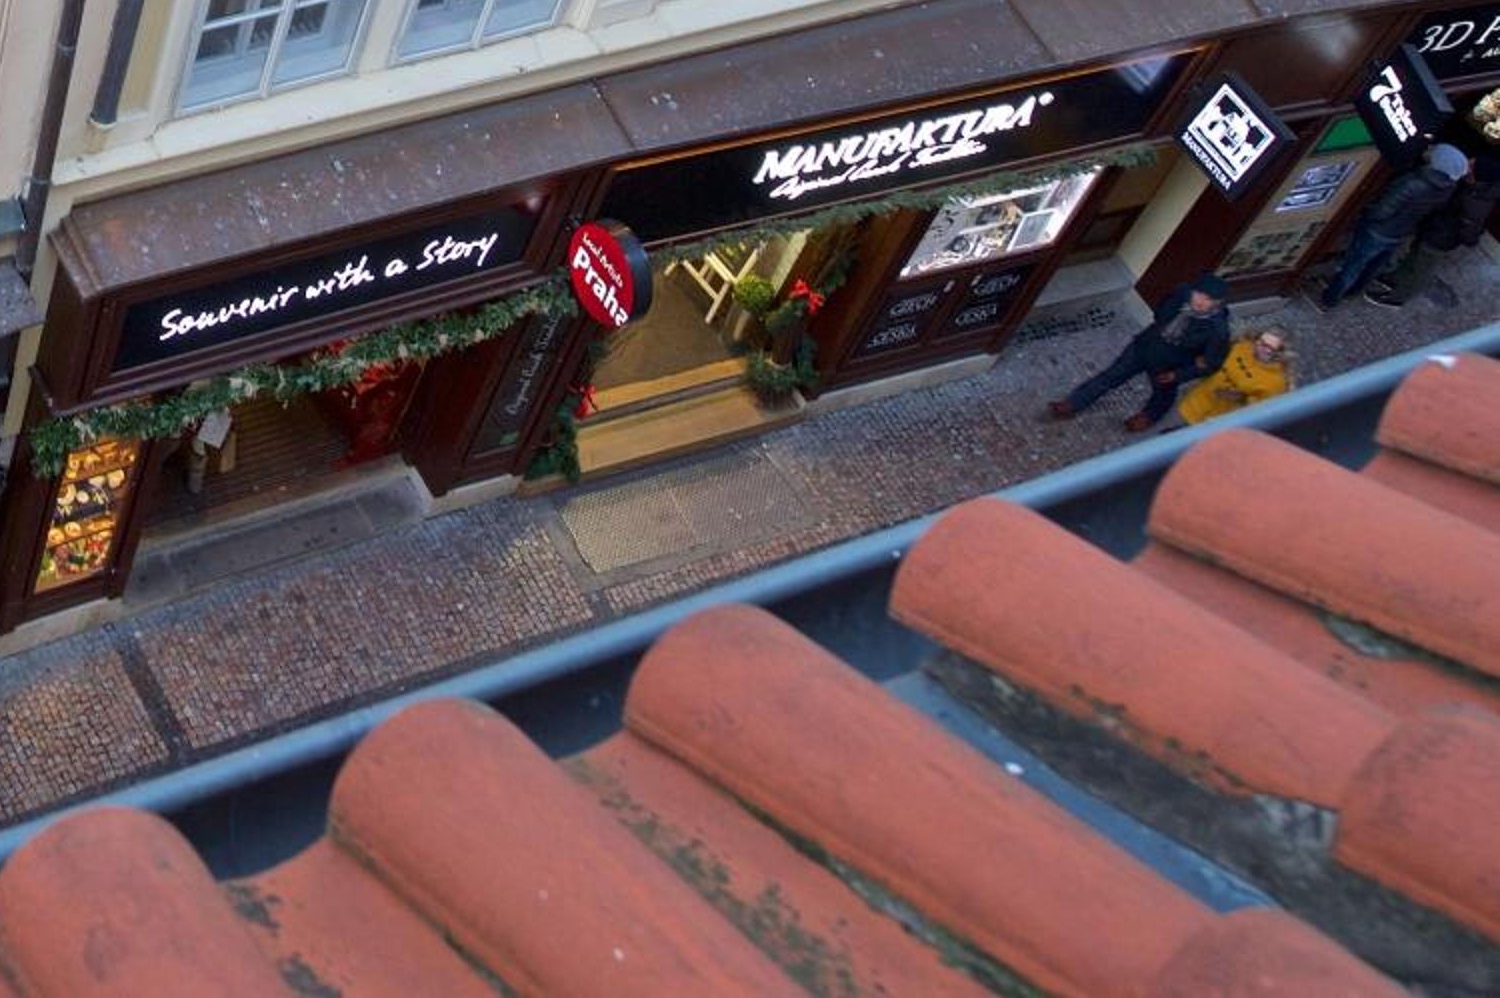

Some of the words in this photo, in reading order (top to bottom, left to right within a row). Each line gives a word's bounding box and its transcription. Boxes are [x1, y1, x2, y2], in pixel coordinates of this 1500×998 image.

[1417, 21, 1475, 53] 3D
[159, 287, 298, 341] Souvenir
[305, 255, 375, 300] with
[384, 259, 409, 277] a
[416, 233, 499, 271] Story
